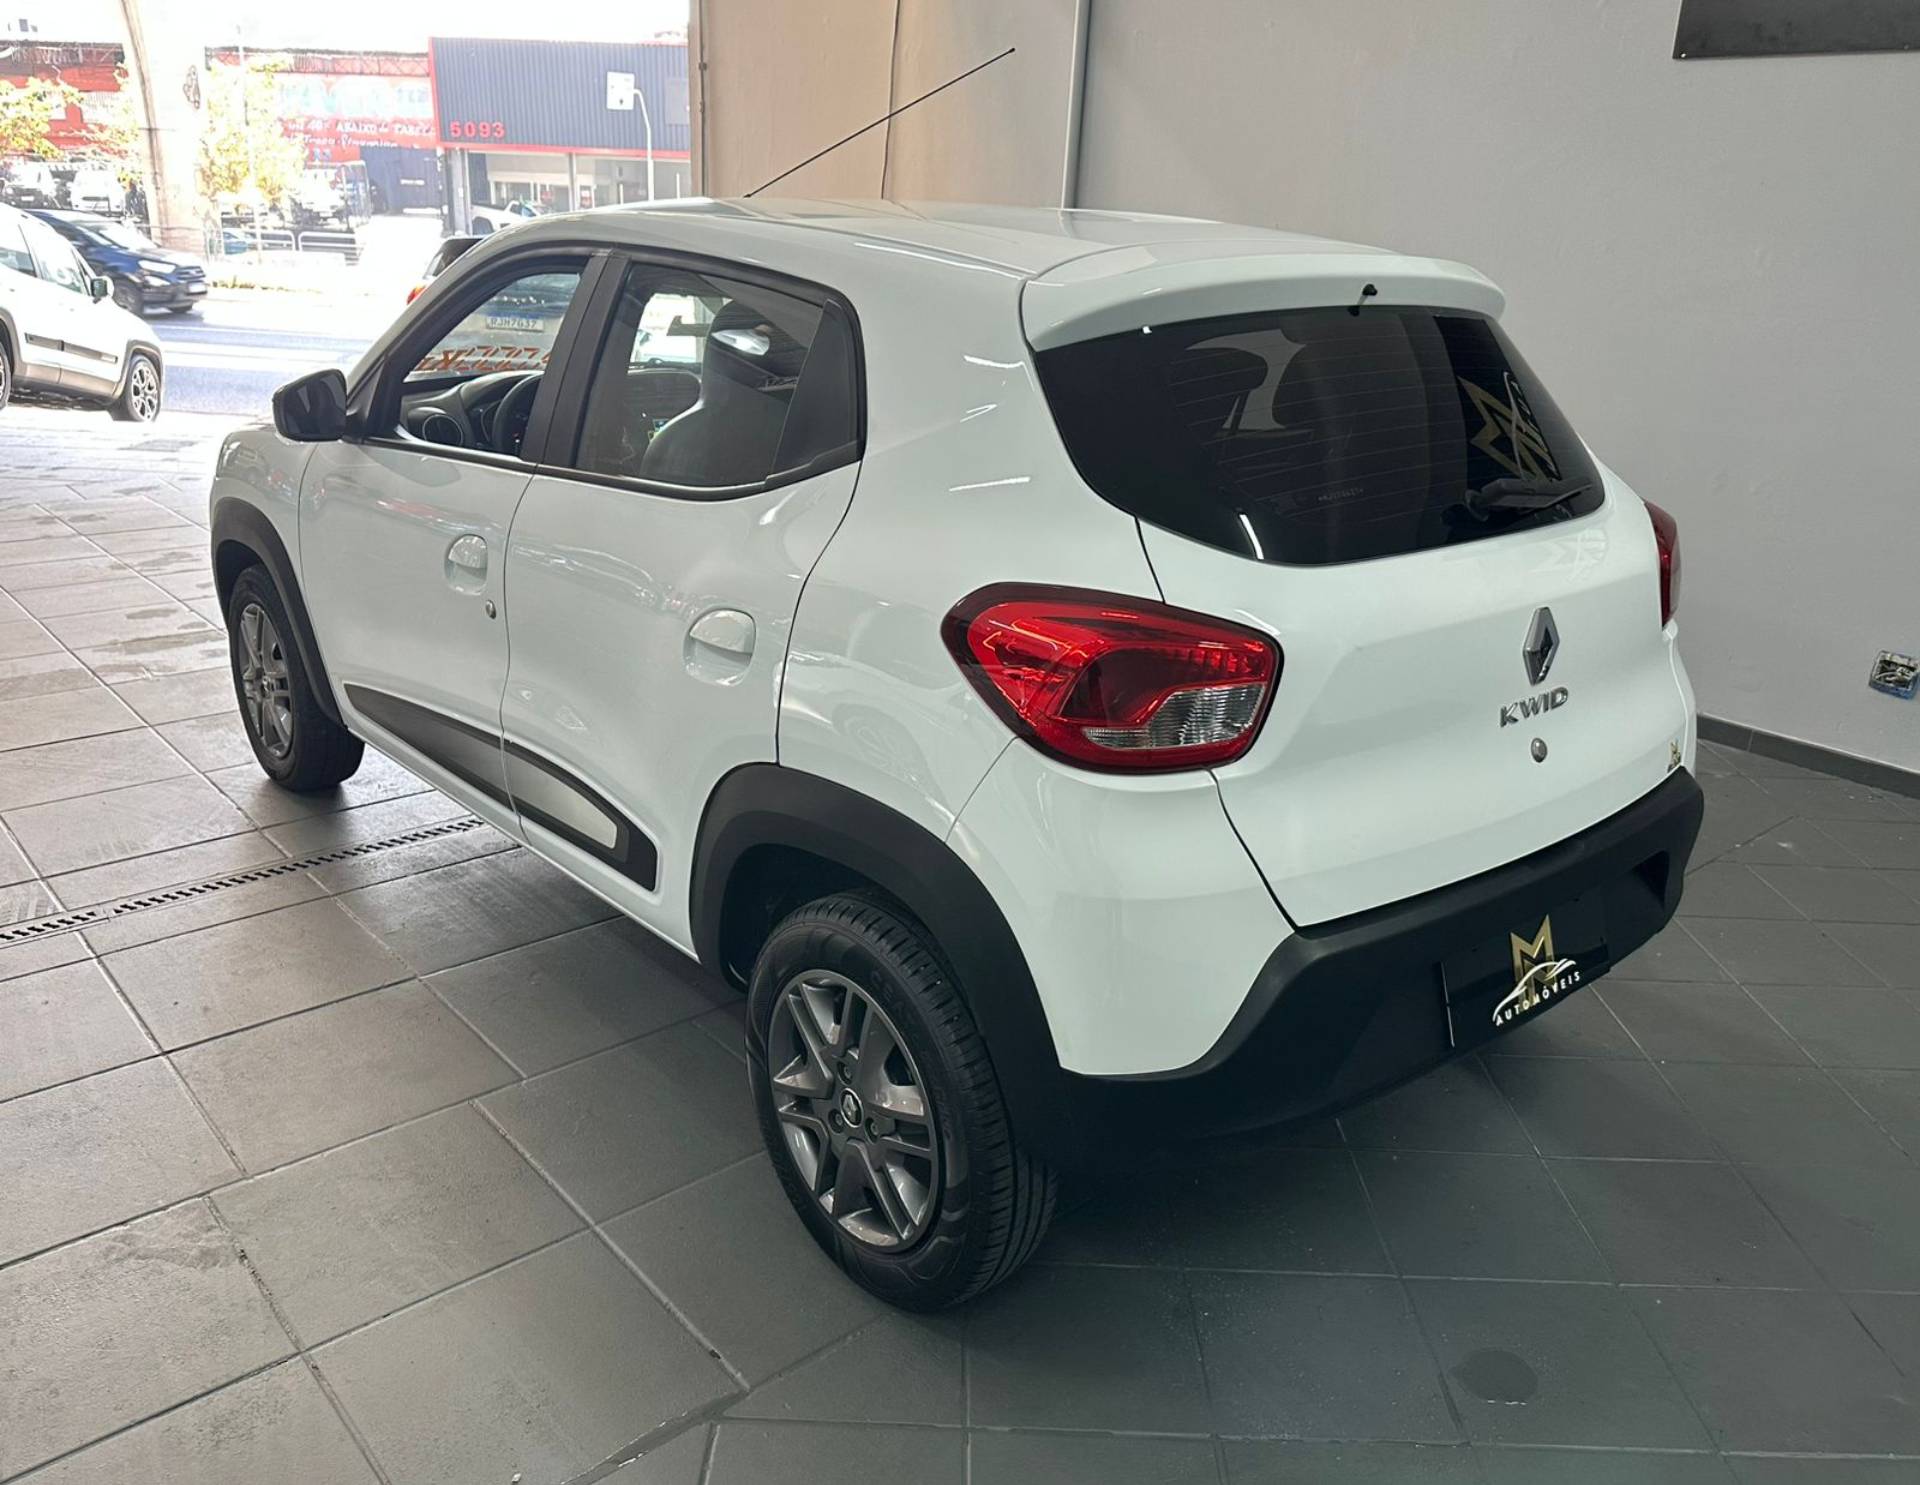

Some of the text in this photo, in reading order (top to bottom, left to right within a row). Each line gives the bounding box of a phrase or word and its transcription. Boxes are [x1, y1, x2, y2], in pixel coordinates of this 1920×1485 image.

[449, 120, 505, 138] 5093
[1500, 686, 1568, 728] KWID
[1496, 971, 1580, 1027] AUTOMÓVEIS
